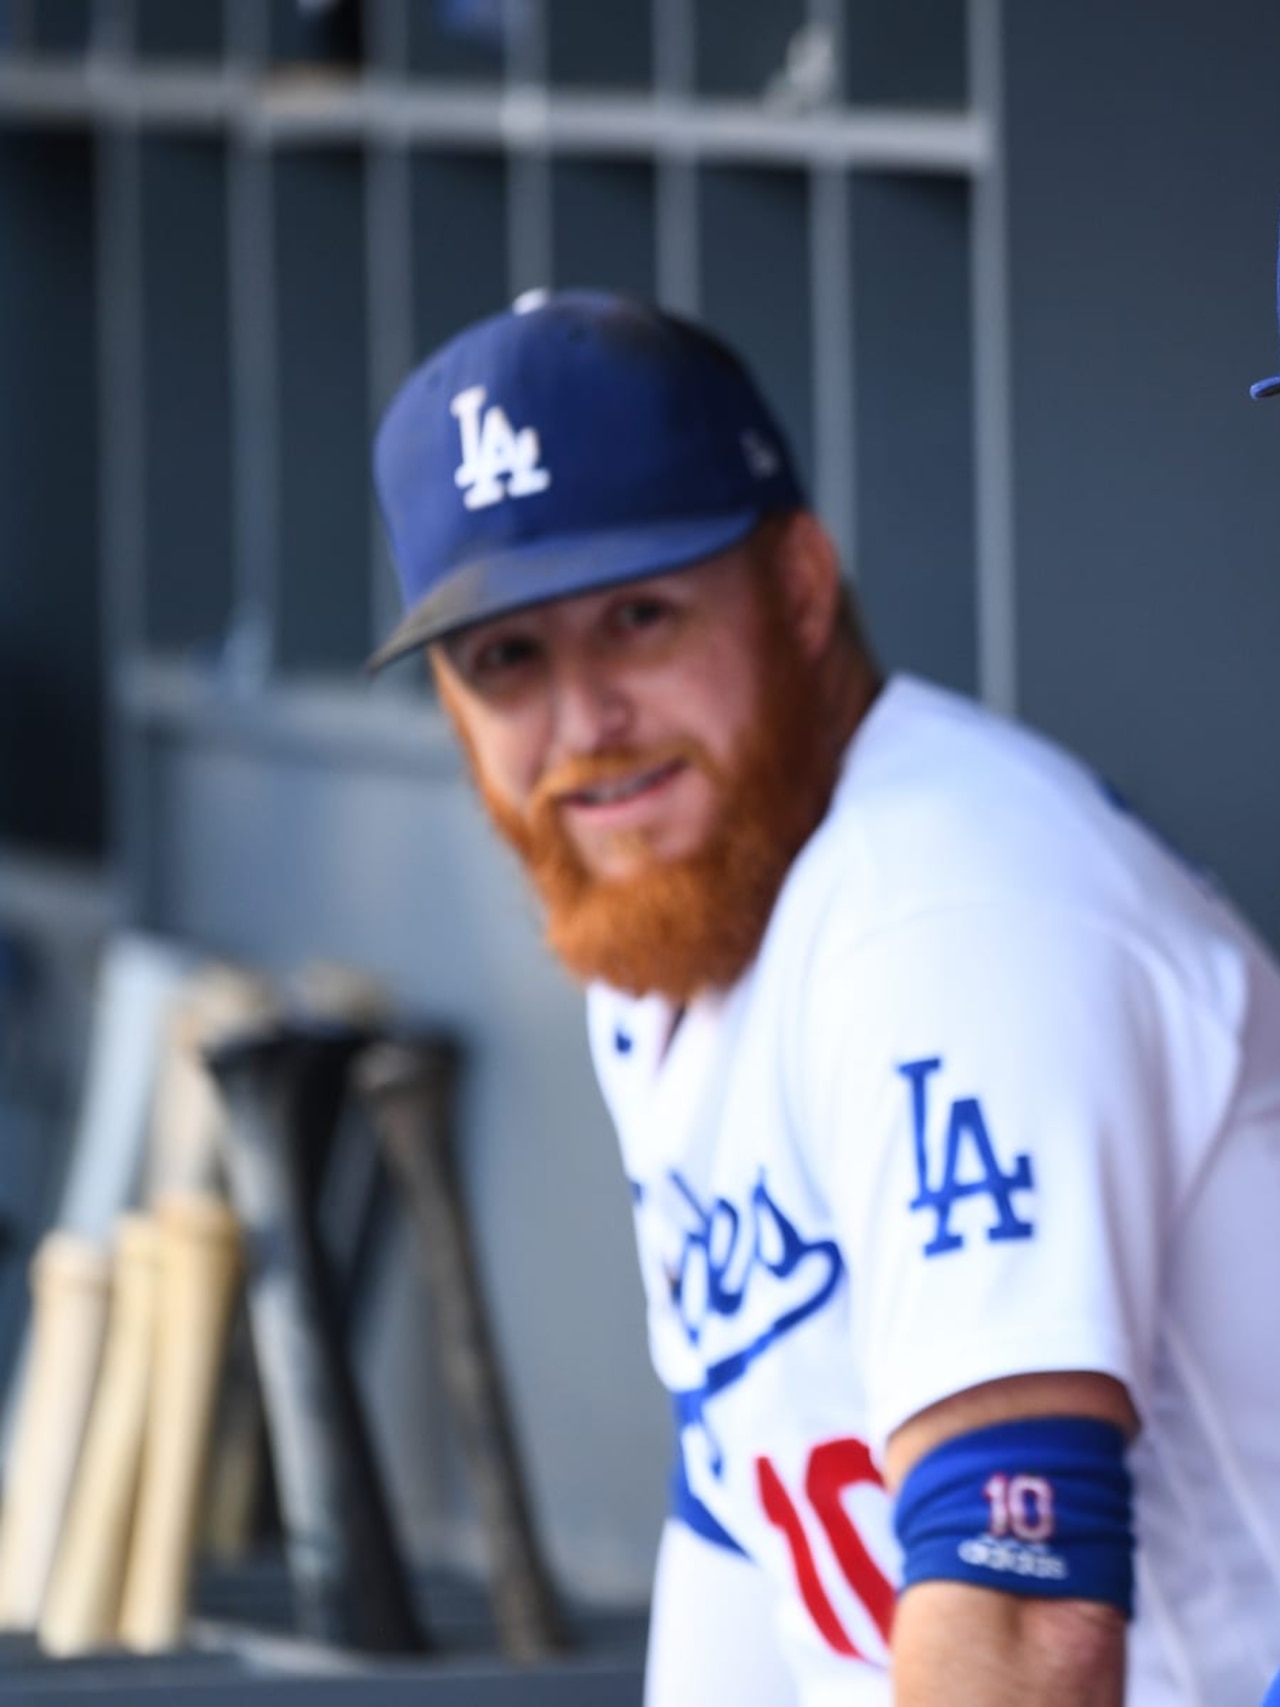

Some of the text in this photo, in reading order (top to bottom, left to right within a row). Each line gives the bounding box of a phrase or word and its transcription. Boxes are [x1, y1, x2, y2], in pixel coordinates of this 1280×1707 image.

[449, 384, 551, 511] LA
[897, 1056, 1036, 1258] LA
[983, 1472, 1055, 1542] 10
